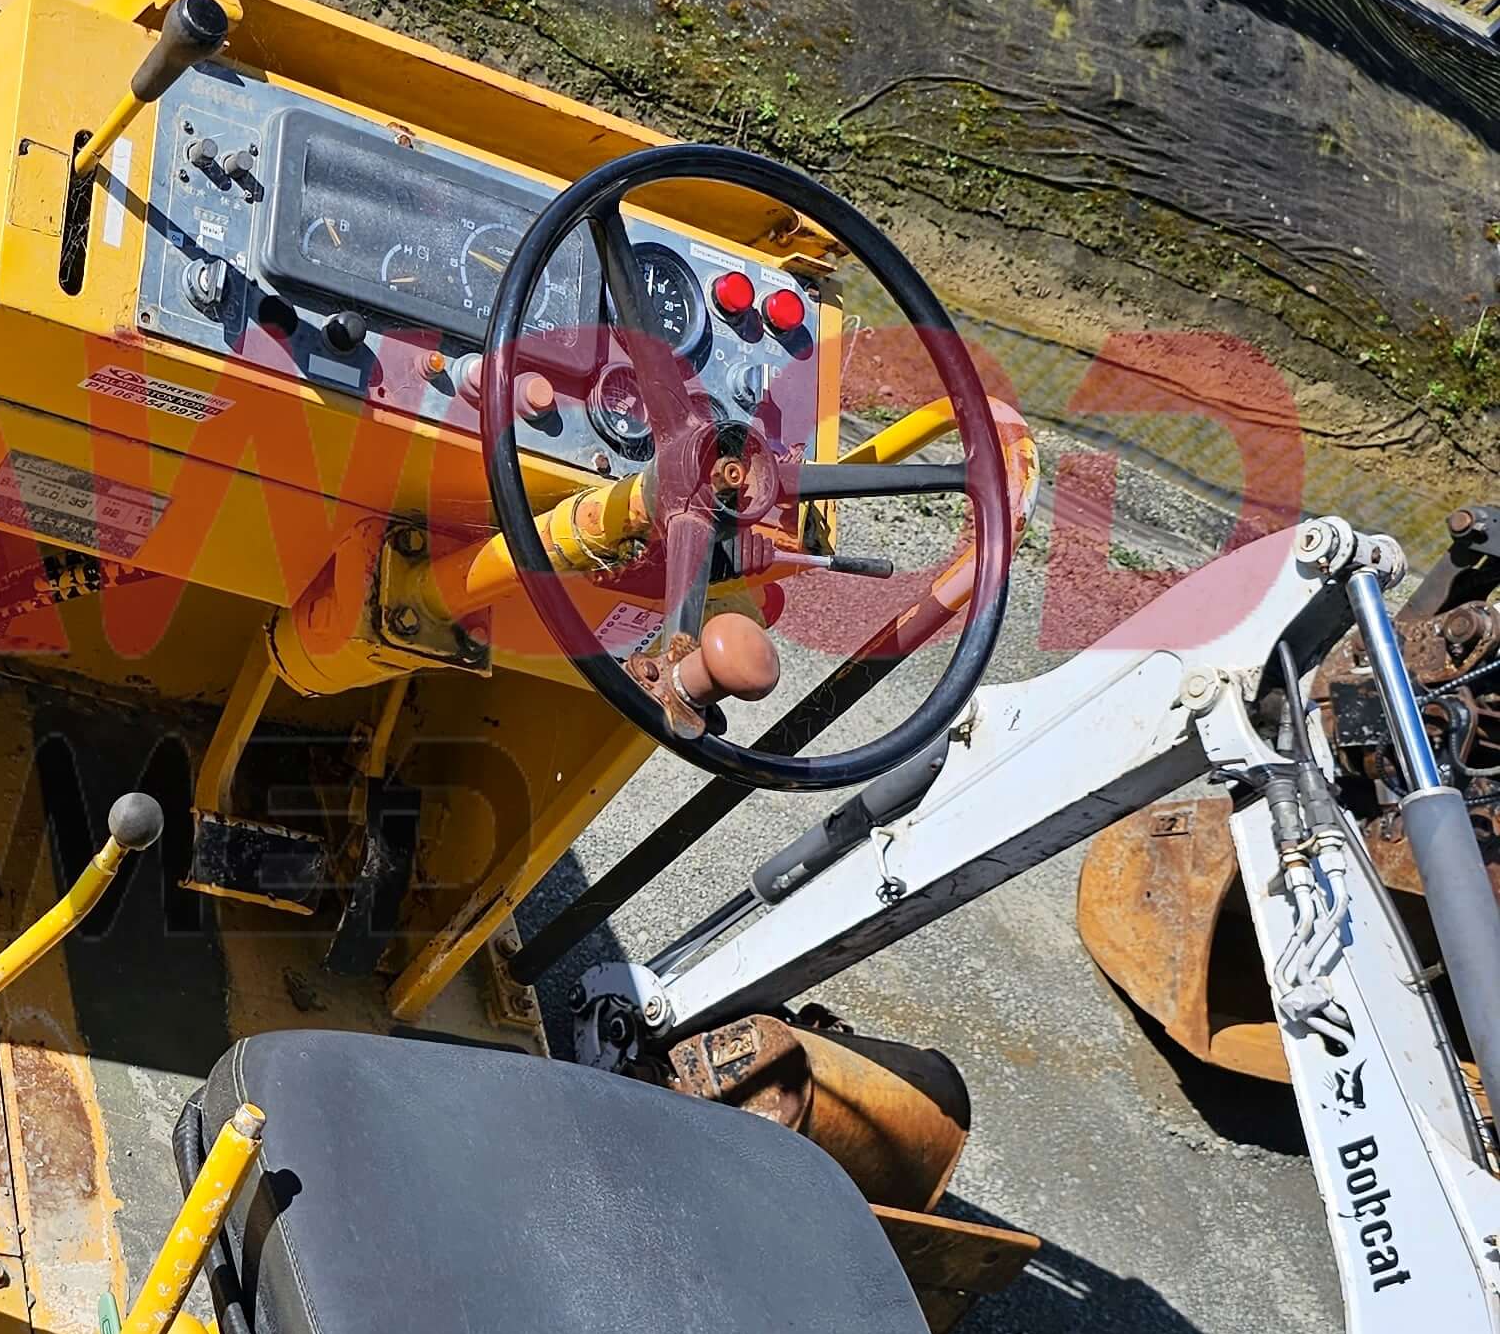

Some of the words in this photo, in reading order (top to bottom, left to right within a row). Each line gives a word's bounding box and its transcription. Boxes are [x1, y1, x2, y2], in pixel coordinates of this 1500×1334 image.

[664, 301, 674, 312] 20
[85, 381, 109, 394] PH
[112, 389, 133, 401] 06
[135, 395, 165, 411] 354
[167, 404, 207, 421] 9970
[177, 397, 221, 416] NORTH
[1338, 1134, 1412, 1293] Bobcat
